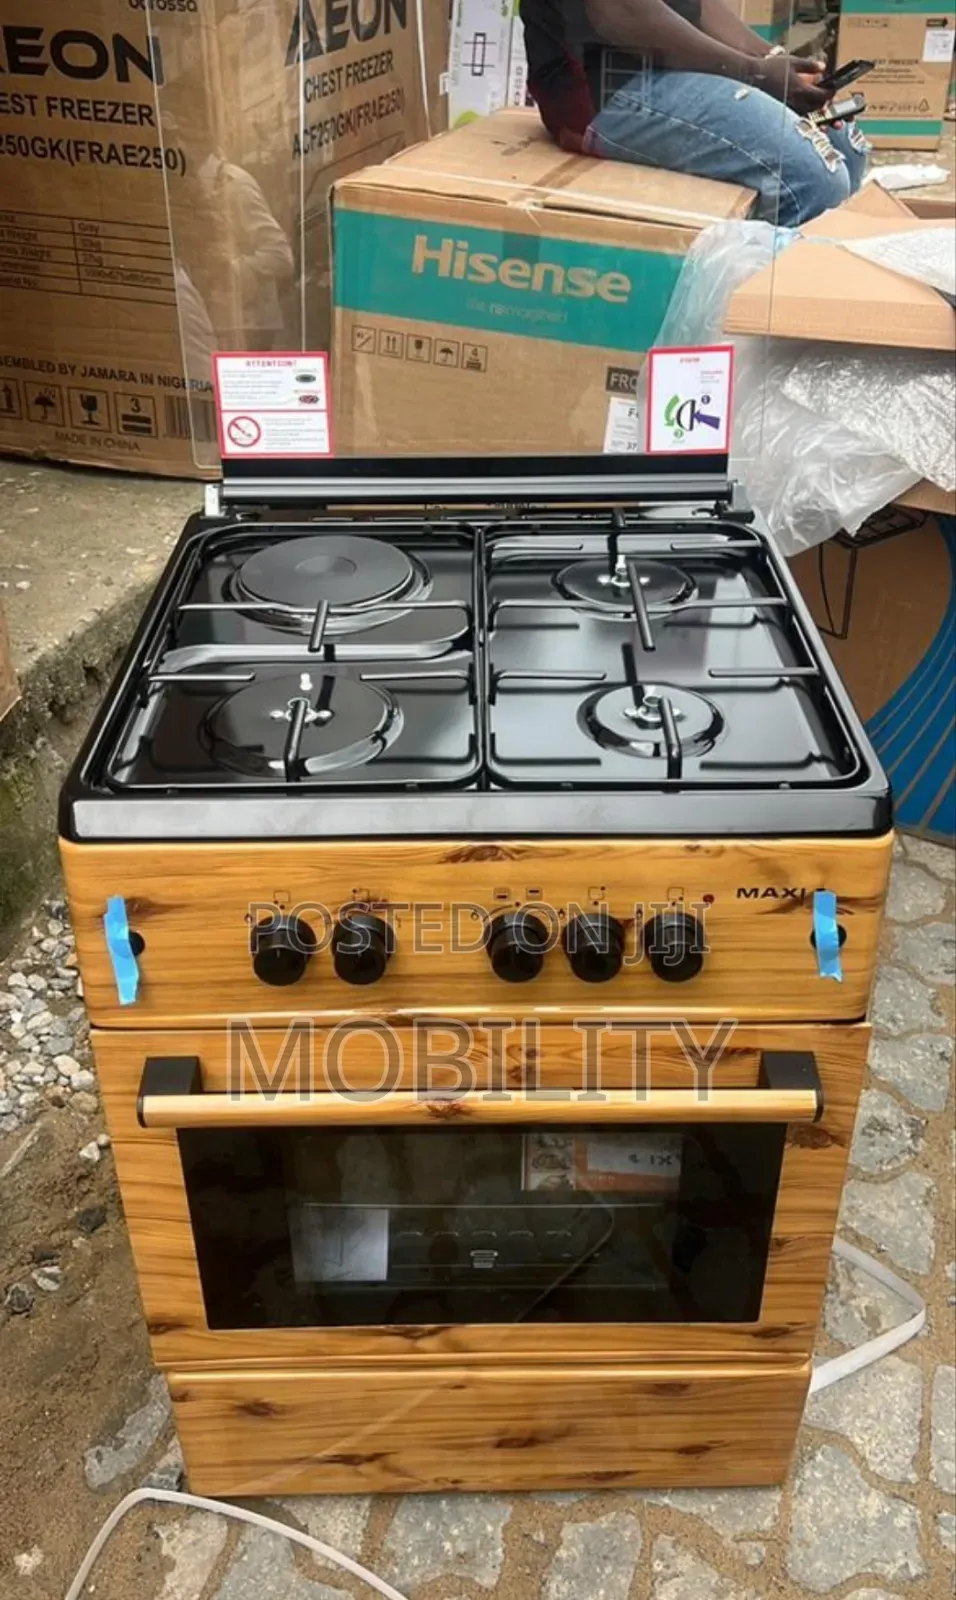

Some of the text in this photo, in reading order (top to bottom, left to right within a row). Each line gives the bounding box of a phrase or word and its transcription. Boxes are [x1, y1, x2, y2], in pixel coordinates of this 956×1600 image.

[0, 25, 165, 87] EON
[303, 50, 394, 104] CHEST FREEZER
[46, 96, 155, 127] FREEZER
[411, 234, 632, 303] Hisense
[58, 360, 77, 377] BY
[140, 372, 155, 386] IN
[737, 886, 807, 900] MAXI
